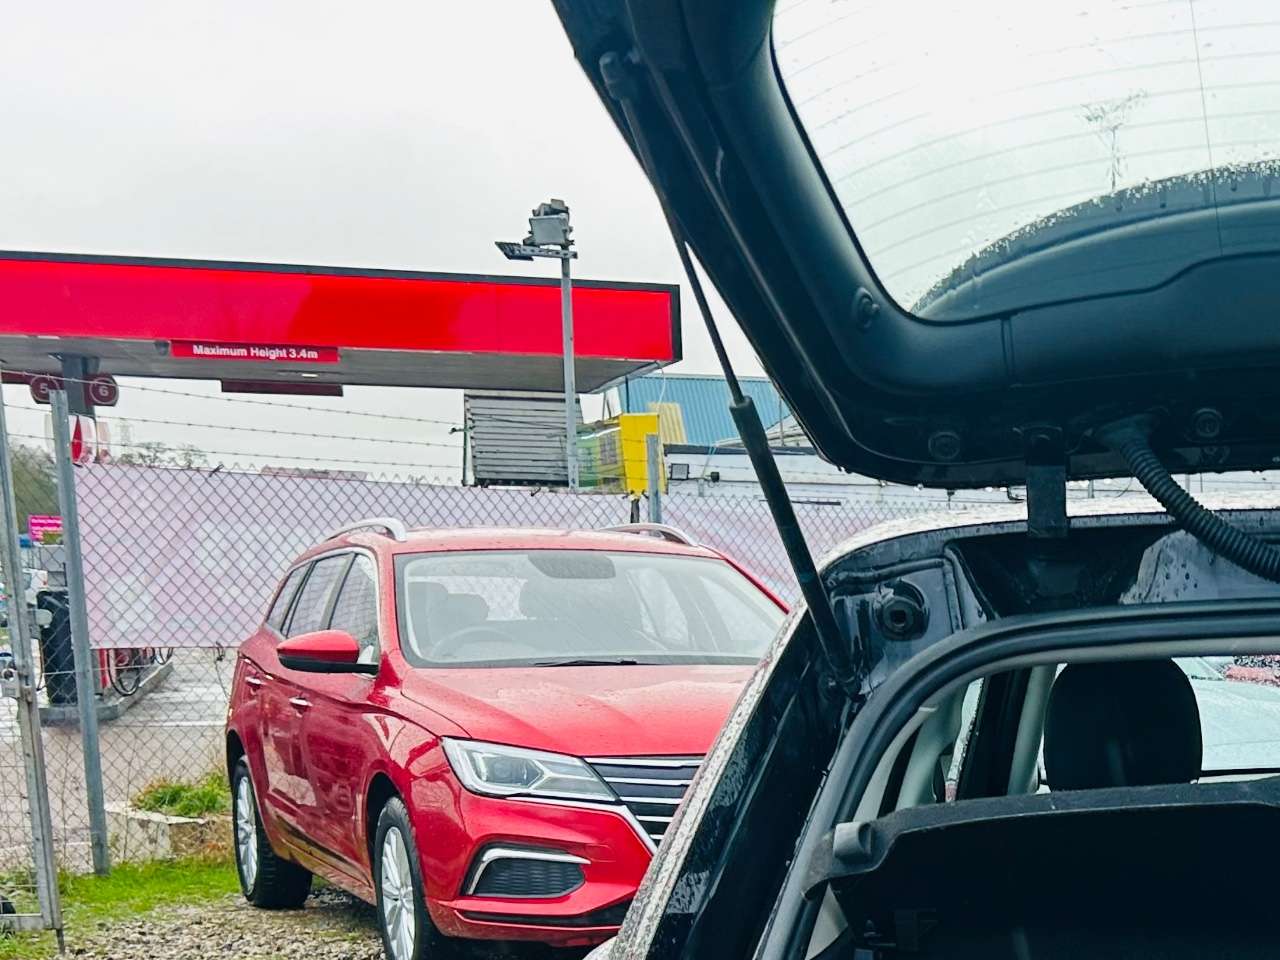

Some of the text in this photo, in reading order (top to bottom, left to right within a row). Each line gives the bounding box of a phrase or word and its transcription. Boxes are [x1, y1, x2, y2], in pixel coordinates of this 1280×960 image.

[193, 344, 318, 360] Maximum Height 3.4m
[40, 382, 49, 394] 5
[99, 385, 109, 397] 6
